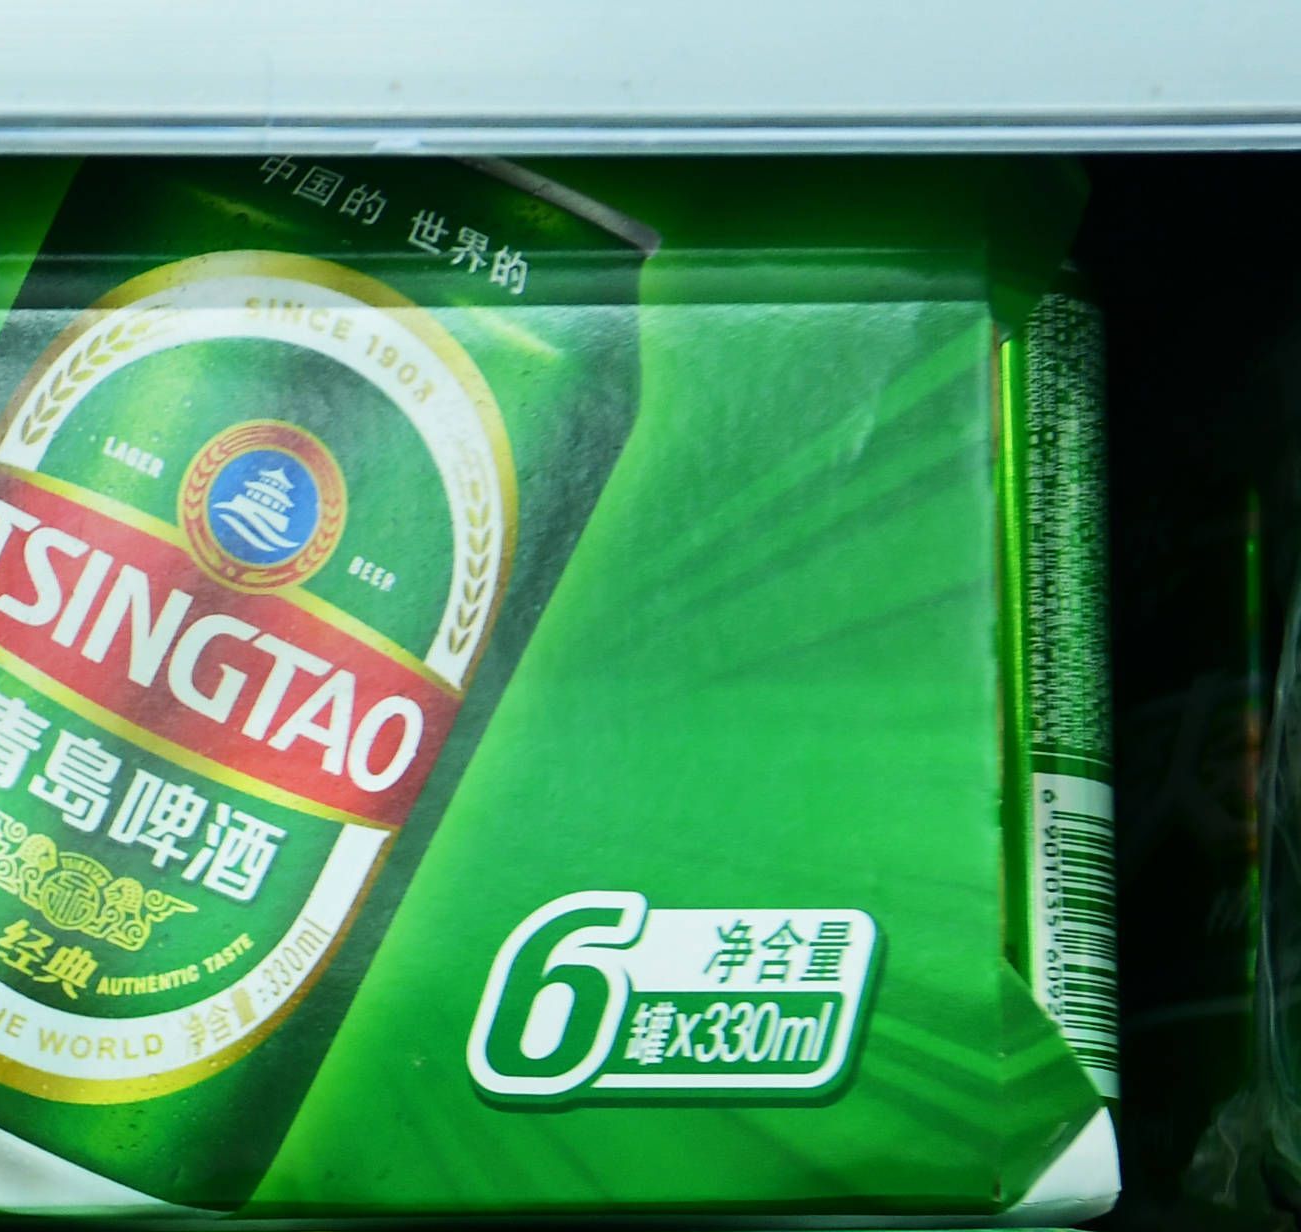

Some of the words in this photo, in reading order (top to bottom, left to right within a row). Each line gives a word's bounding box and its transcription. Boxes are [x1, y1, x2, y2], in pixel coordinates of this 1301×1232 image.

[258, 153, 387, 225] 中国的
[406, 209, 529, 295] 世界的
[244, 296, 349, 344] SINCE
[365, 333, 434, 403] 1903
[103, 435, 165, 478] LAGER
[347, 555, 397, 592] BEER
[96, 964, 201, 997] AUTHENTIC
[201, 932, 255, 975] TASTE
[705, 919, 851, 983] 净含量
[476, 898, 636, 1086] 6
[37, 1028, 165, 1060] WORLD
